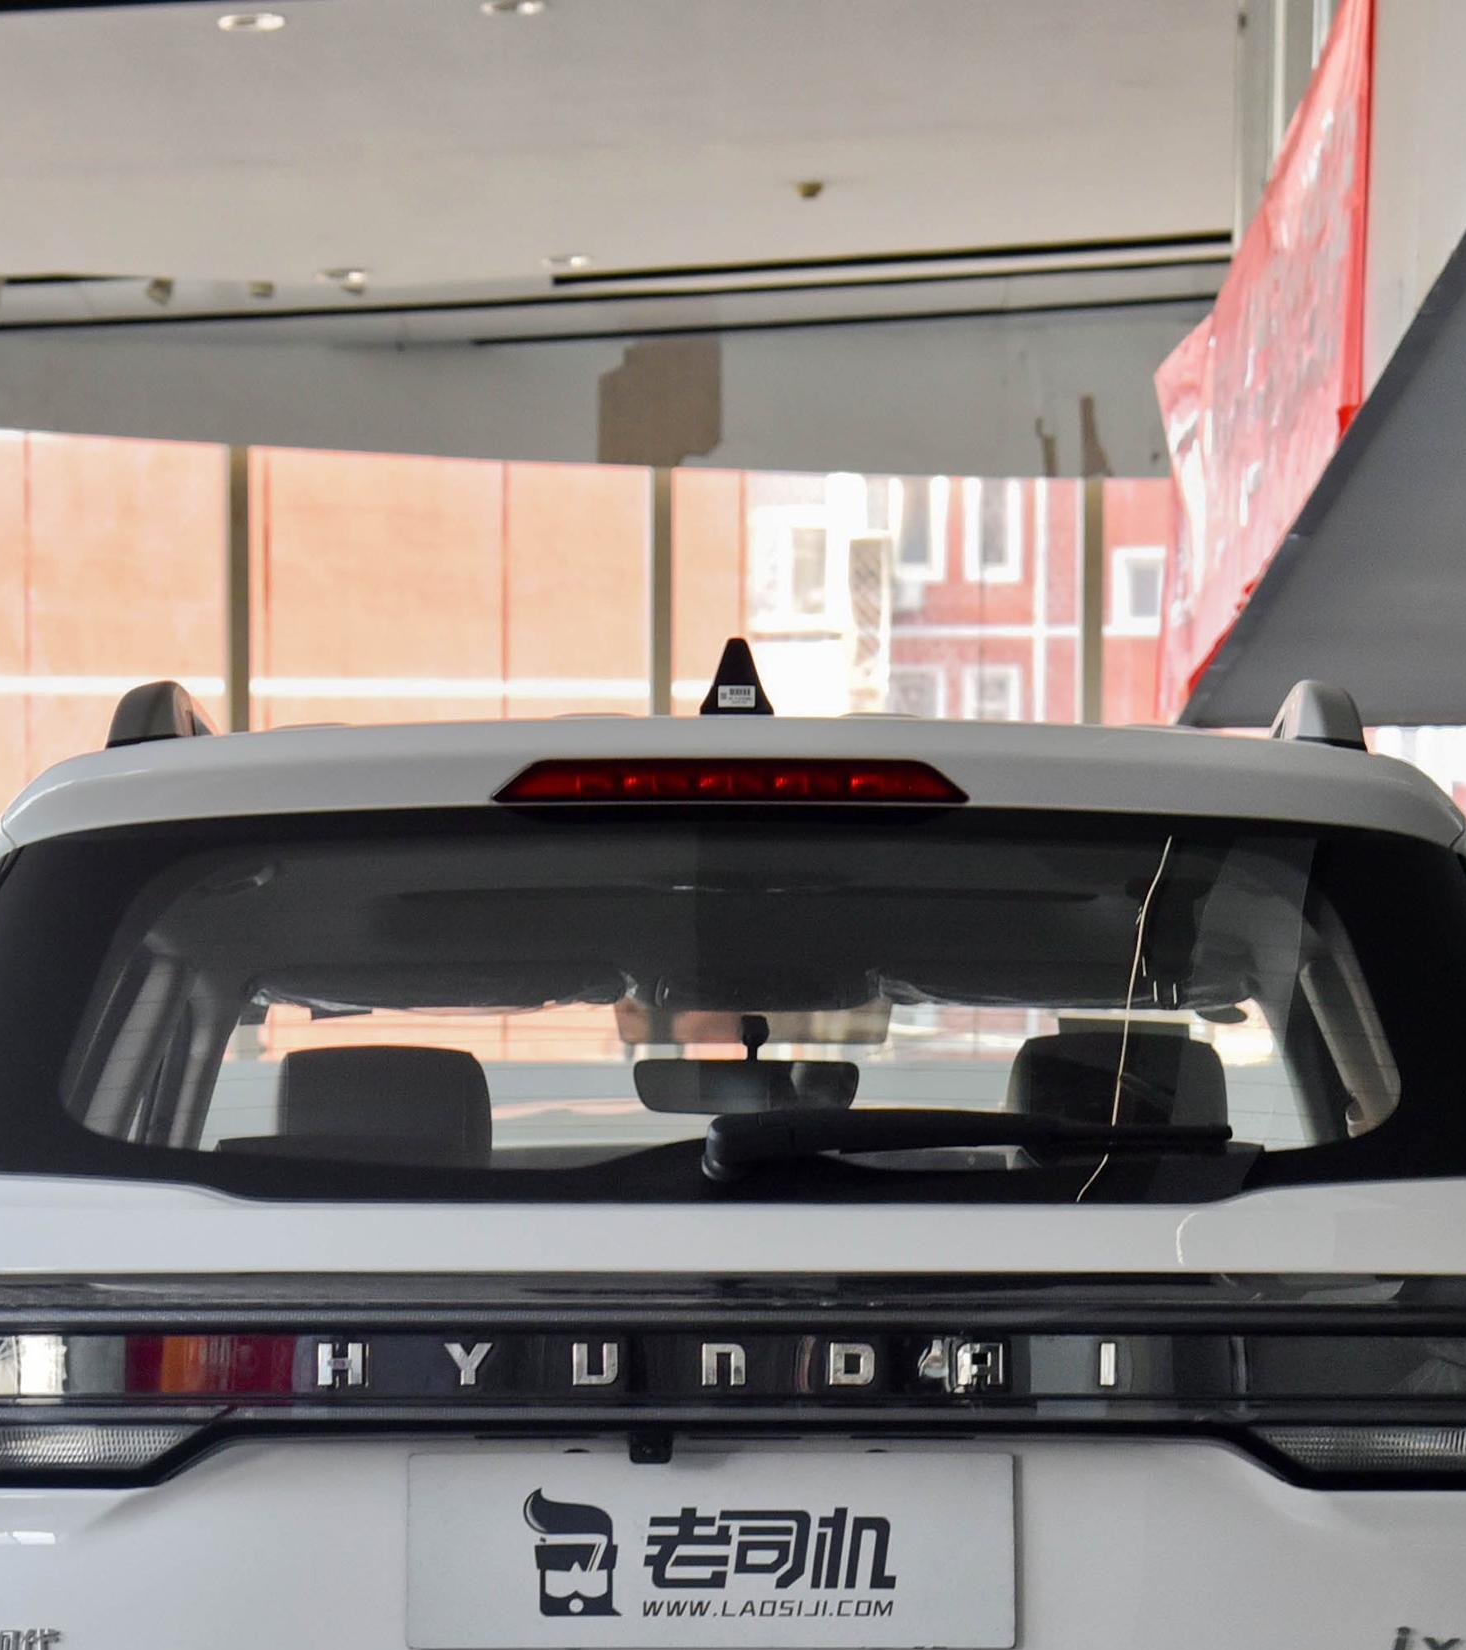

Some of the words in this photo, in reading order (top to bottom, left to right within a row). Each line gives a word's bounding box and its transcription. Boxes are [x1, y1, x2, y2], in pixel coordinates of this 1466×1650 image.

[317, 1342, 1116, 1386] HYUNDAI
[643, 1507, 897, 1589] 老司机
[642, 1599, 894, 1617] WWW.LAOSIJI.COM
